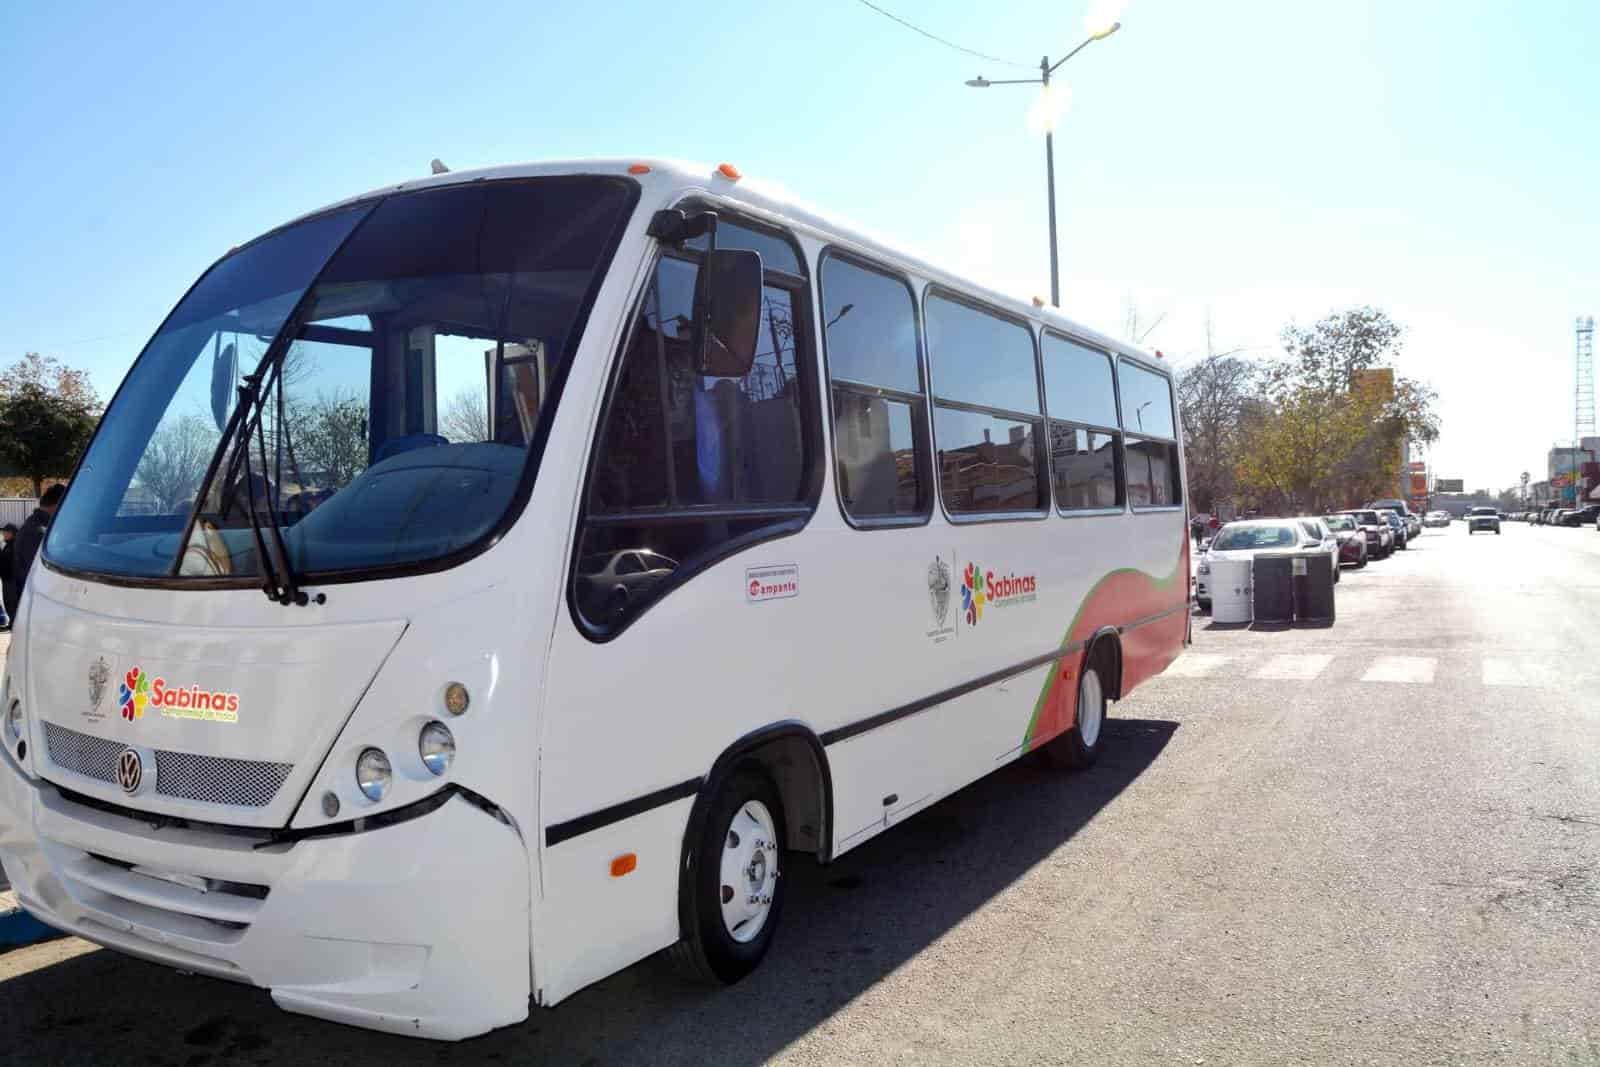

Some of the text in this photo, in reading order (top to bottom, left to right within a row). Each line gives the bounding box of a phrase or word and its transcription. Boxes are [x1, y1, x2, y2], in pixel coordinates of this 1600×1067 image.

[984, 571, 1036, 602] Sabinas
[152, 678, 239, 712] Sabinas
[119, 749, 142, 792] VW
